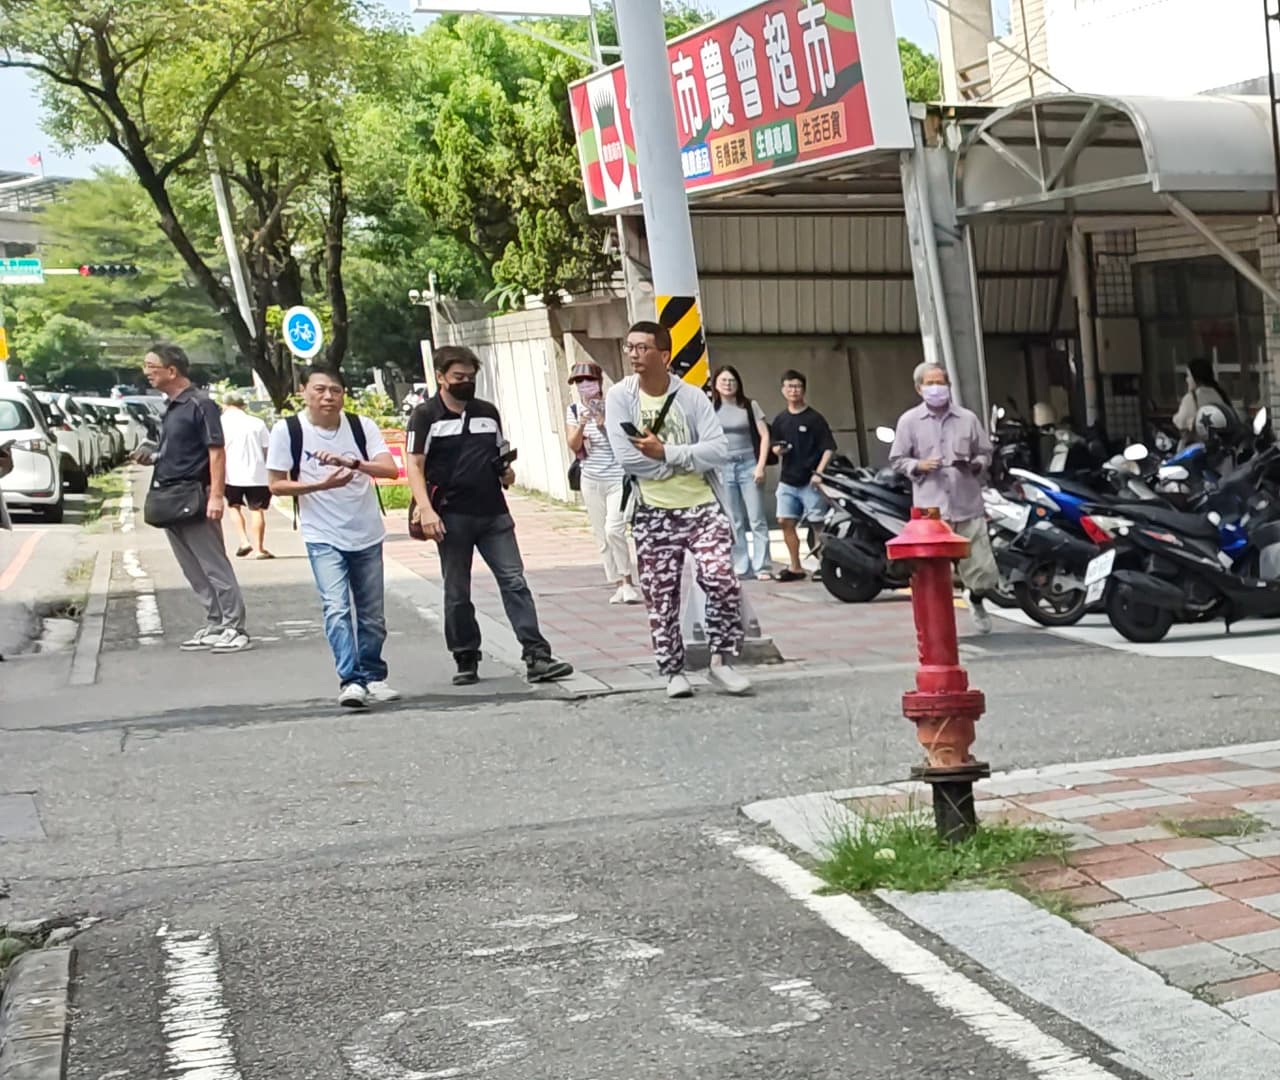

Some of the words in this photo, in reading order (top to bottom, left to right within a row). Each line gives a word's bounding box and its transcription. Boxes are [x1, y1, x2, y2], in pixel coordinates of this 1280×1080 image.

[626, 0, 836, 138] 市農會超市
[801, 110, 842, 147] 生活百貨
